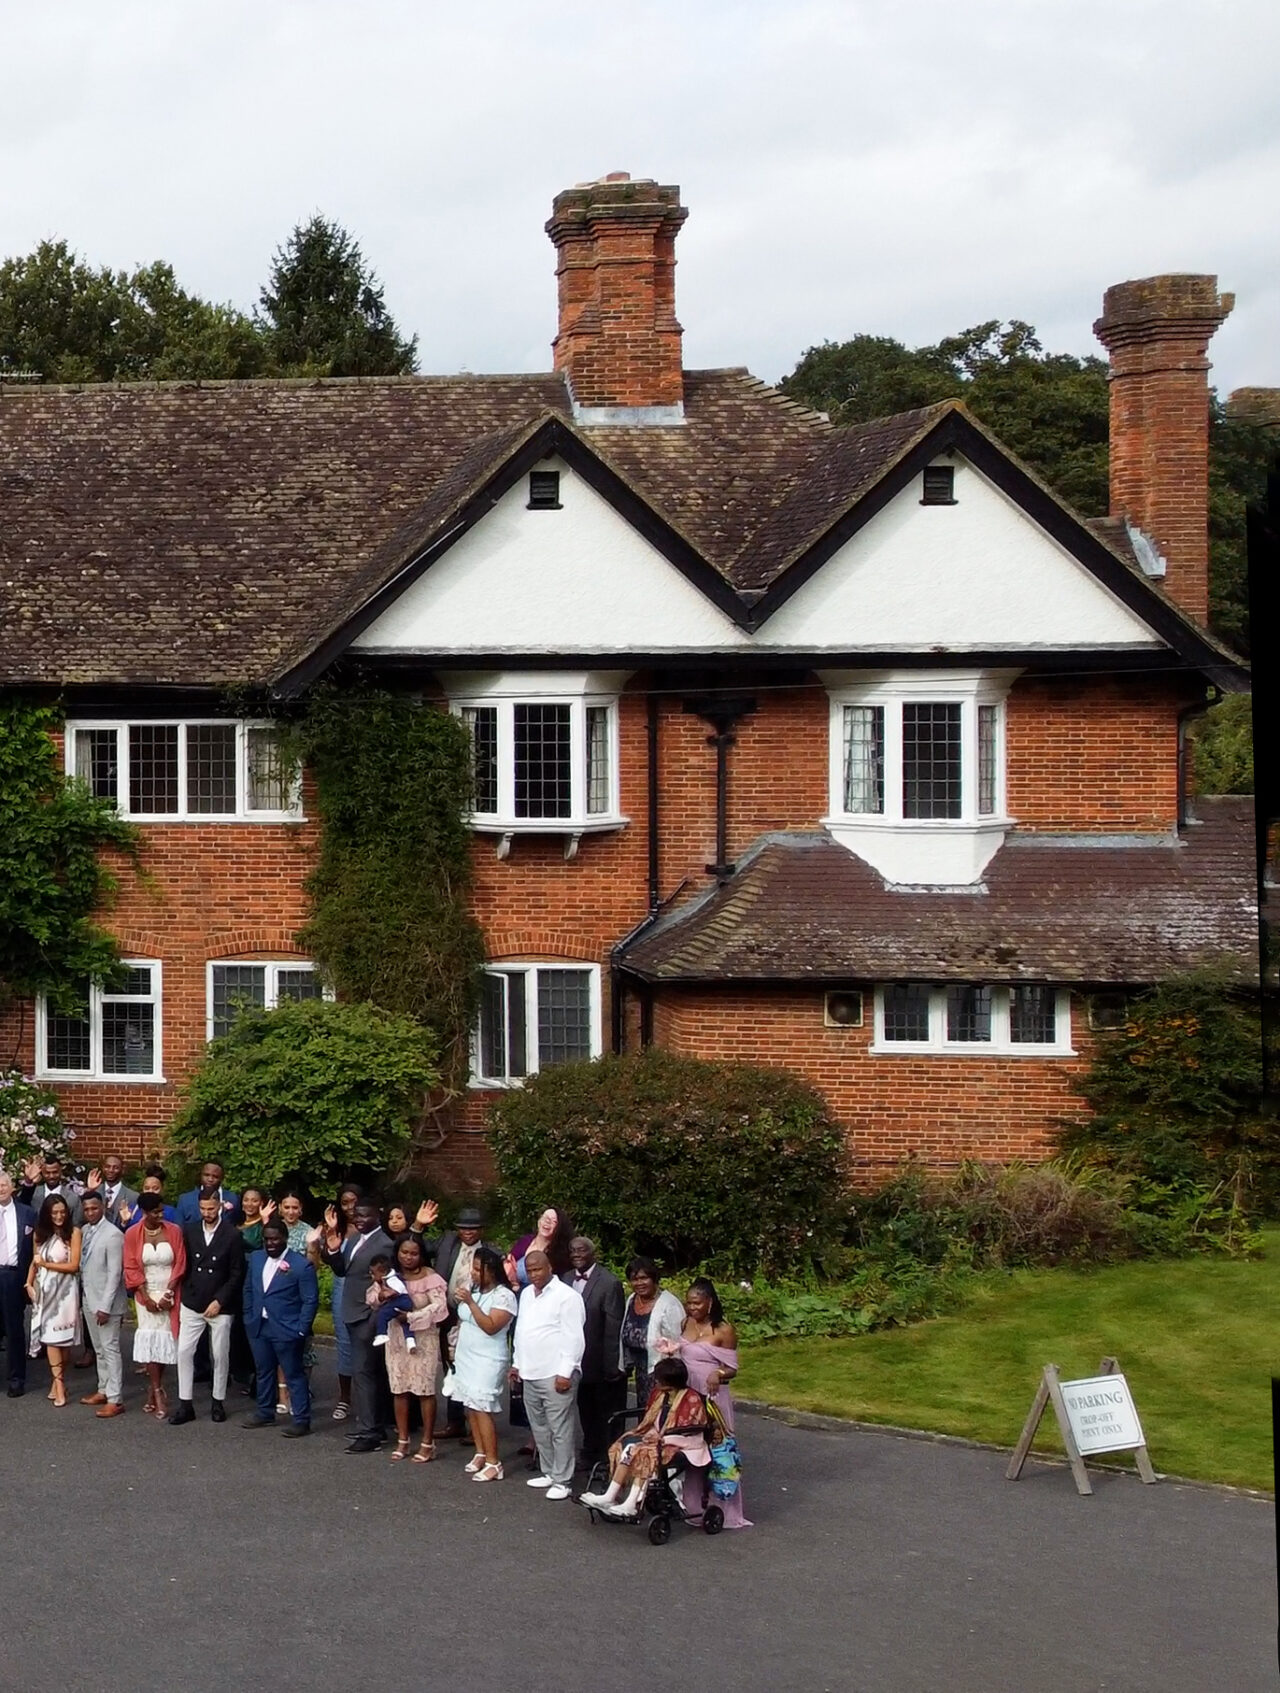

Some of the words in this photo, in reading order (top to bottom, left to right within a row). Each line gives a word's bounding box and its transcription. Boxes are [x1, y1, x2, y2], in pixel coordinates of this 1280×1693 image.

[1067, 1397, 1078, 1410] NO
[1077, 1391, 1123, 1409] PARKING
[1102, 1424, 1123, 1435] ONLY
